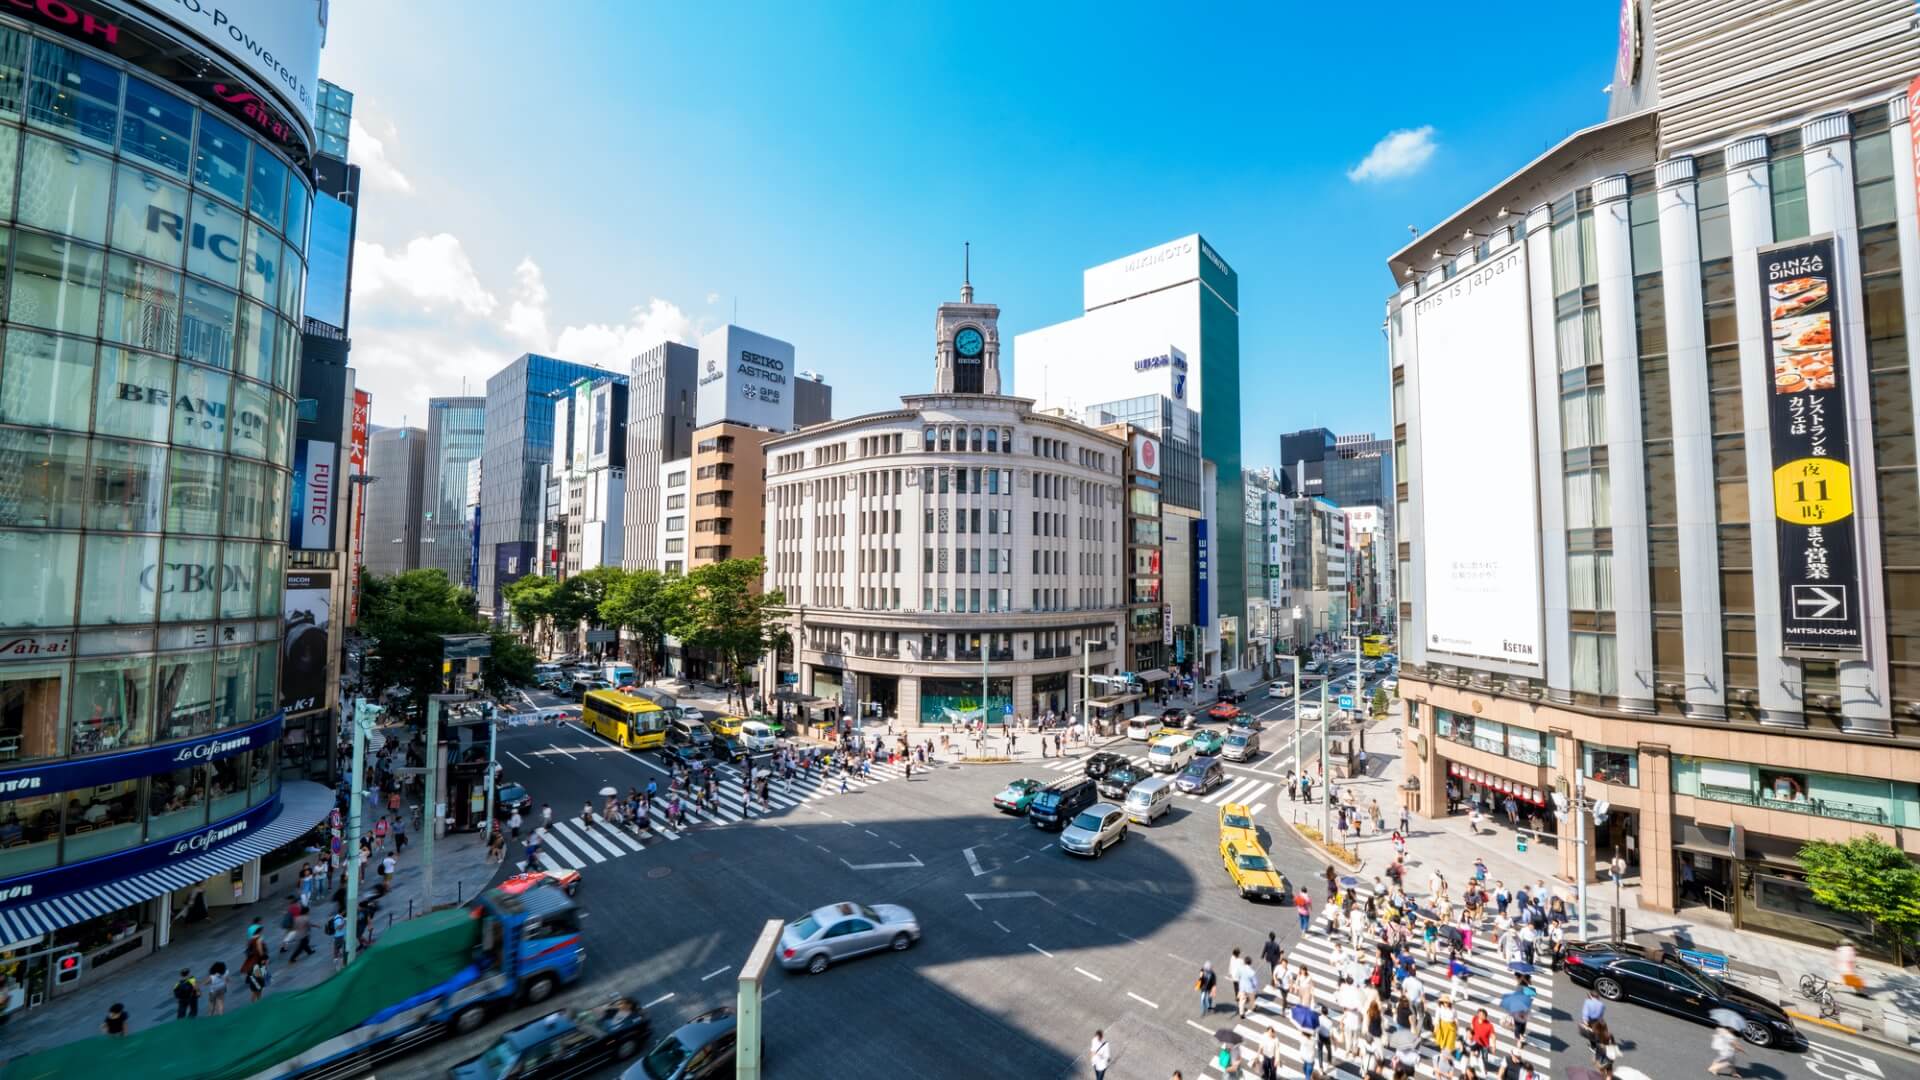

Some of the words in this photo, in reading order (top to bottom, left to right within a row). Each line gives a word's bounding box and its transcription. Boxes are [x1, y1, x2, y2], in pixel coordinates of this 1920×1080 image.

[1769, 255, 1823, 273] GINZA
[1769, 263, 1824, 281] DINING
[1416, 293, 1443, 316] this
[1450, 282, 1462, 300] is
[741, 350, 784, 372] SEIKO
[737, 364, 786, 385] ASTRON
[1788, 396, 1808, 436] カフェは
[307, 463, 330, 527] FUJITEC
[1785, 627, 1858, 636] MITSUKOSHI
